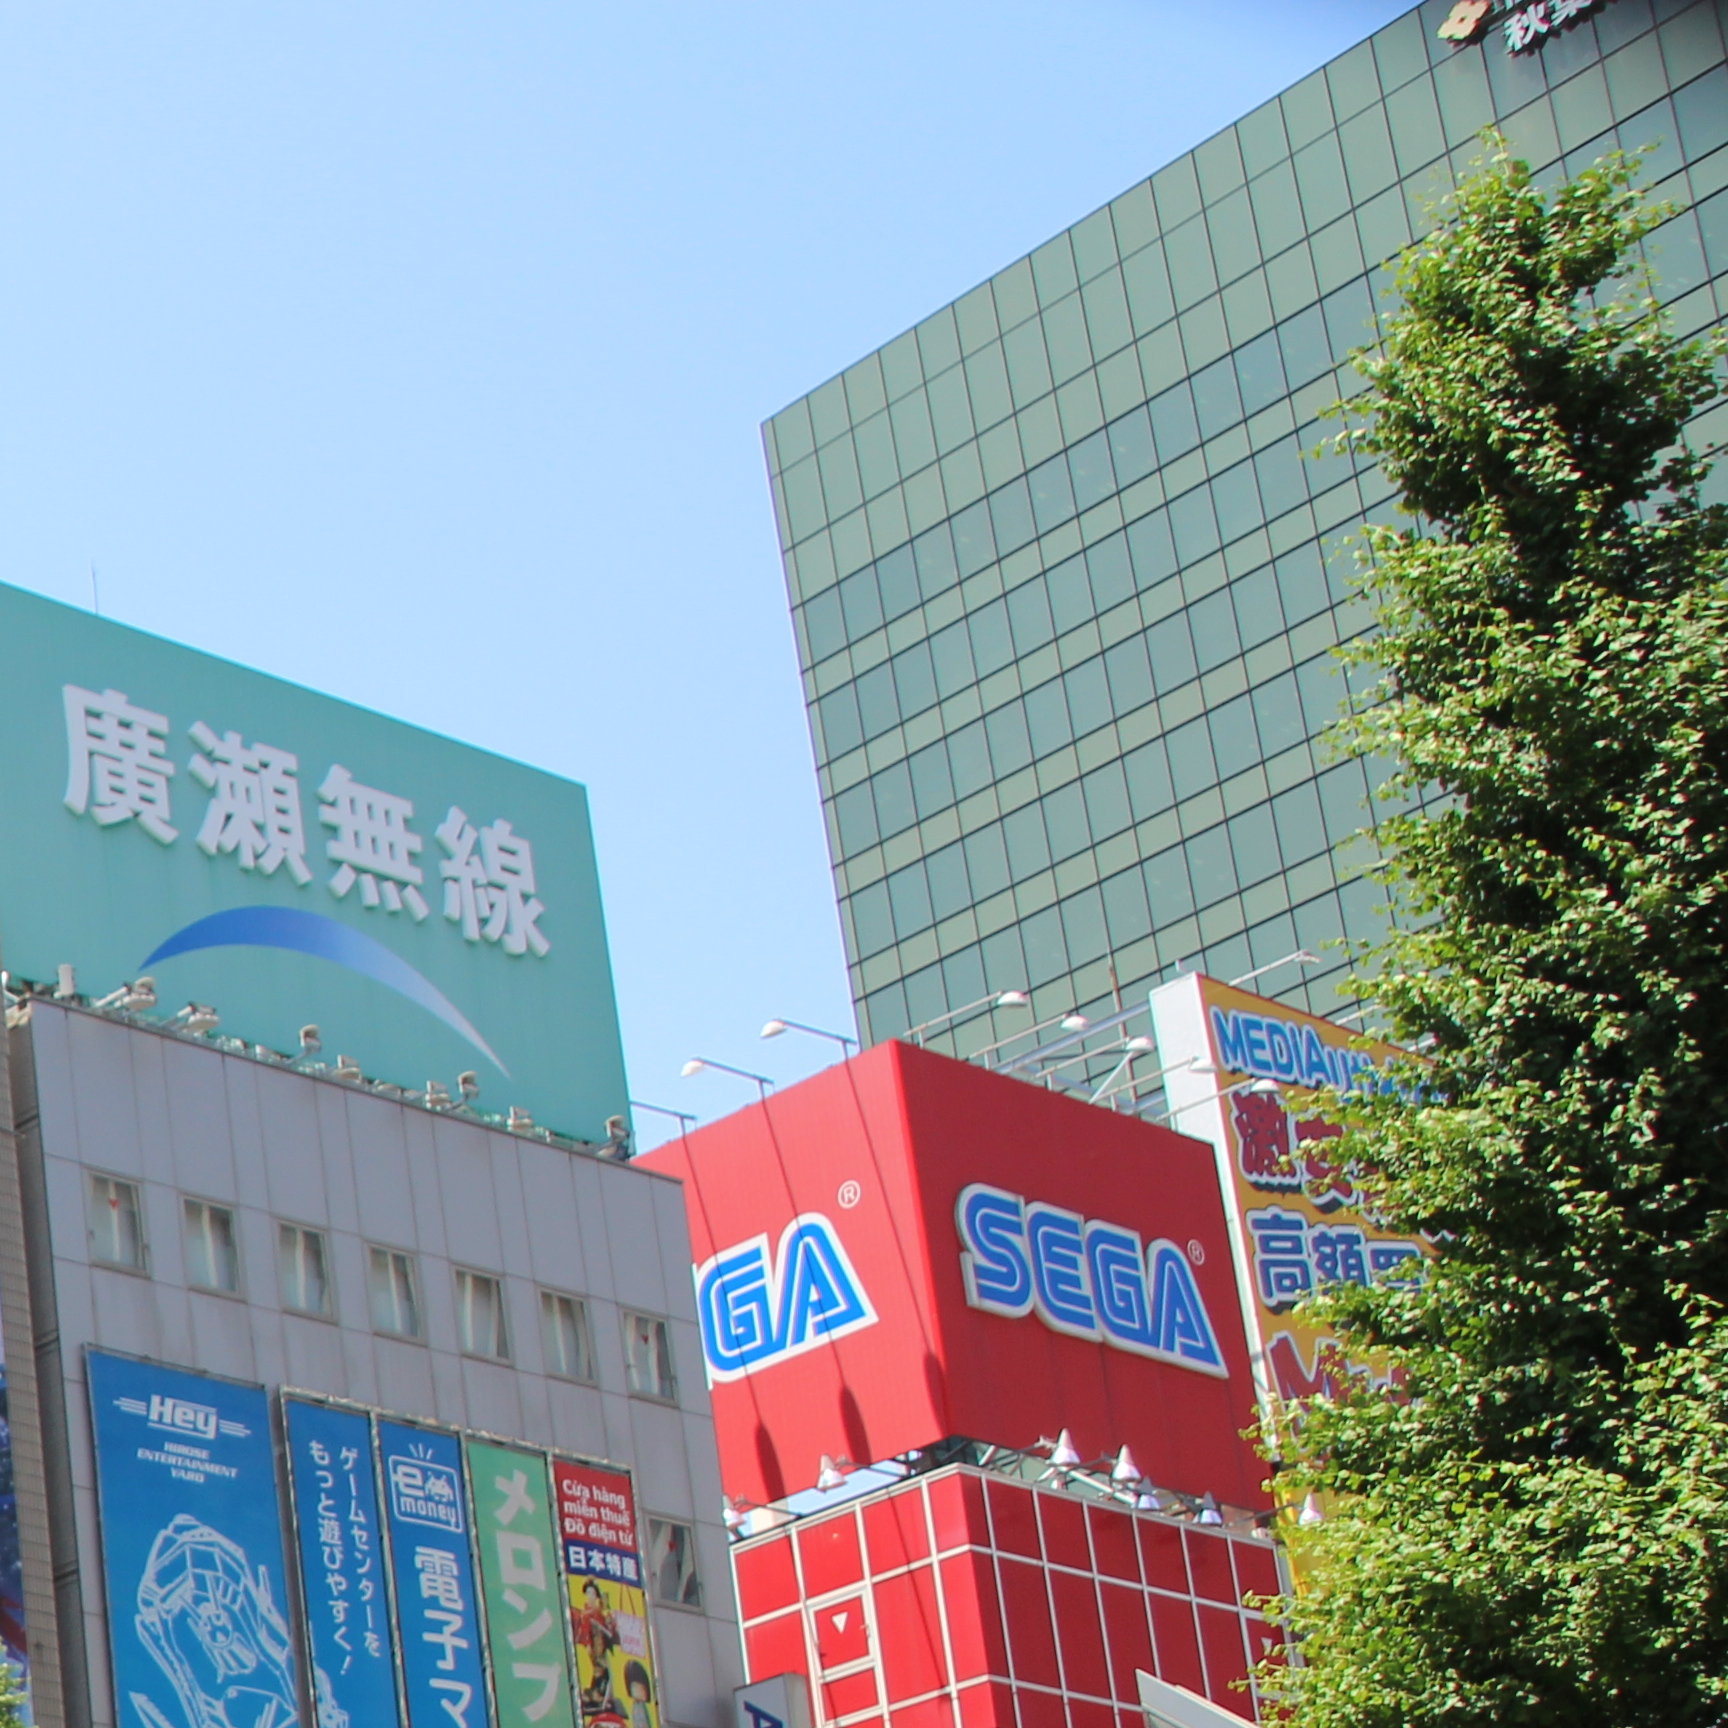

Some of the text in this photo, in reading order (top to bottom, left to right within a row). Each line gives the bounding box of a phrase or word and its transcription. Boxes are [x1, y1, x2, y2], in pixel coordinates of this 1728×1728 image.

[62, 683, 551, 958] 廣瀬無線
[694, 1210, 879, 1392] GA
[955, 1182, 1230, 1380] SEGA
[137, 1447, 238, 1479] ENTERTAINMENT
[147, 1394, 219, 1440] Hey
[339, 1445, 381, 1658] ゲームセンターを
[400, 1495, 457, 1530] money
[568, 1545, 640, 1582] 日本特産
